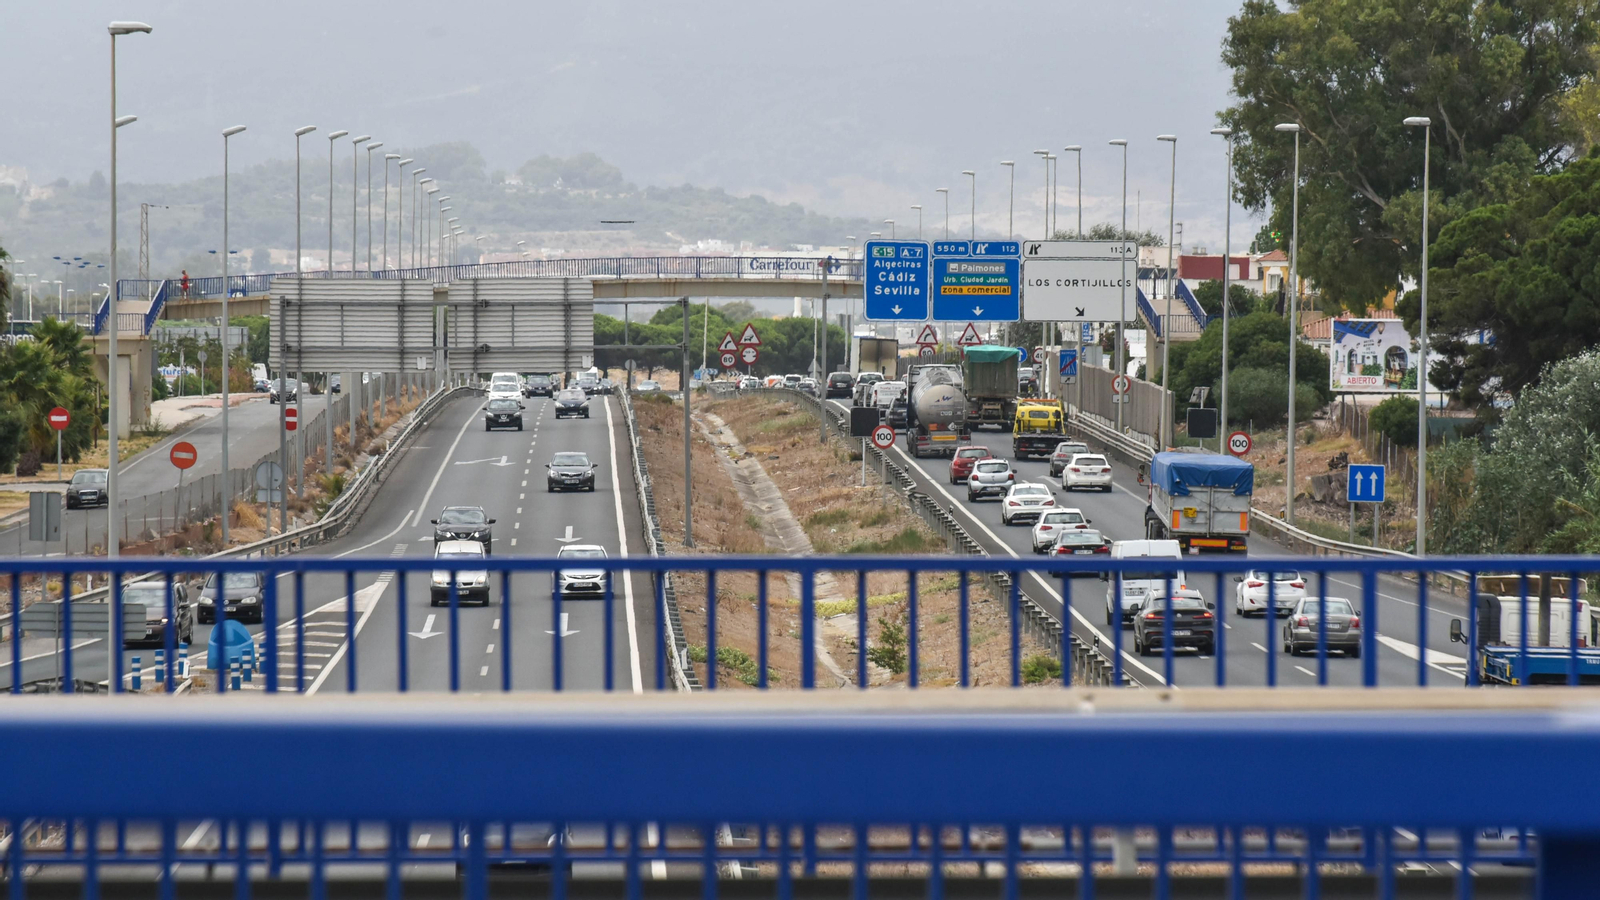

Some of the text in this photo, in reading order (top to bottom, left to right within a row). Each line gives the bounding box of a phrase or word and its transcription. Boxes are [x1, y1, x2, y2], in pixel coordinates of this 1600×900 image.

[873, 247, 922, 257] E-15 A-7
[750, 257, 812, 271] Carrefour
[873, 260, 922, 270] Algeciras
[961, 263, 1005, 272] Palmones
[878, 271, 916, 282] Cádiz
[1028, 279, 1131, 287] LOS CORTIJILLOS
[874, 285, 920, 295] Sevilla
[942, 286, 1010, 294] zona comercial
[1347, 377, 1377, 385] ABIERTO
[876, 432, 891, 441] 100
[1232, 439, 1248, 448] 100
